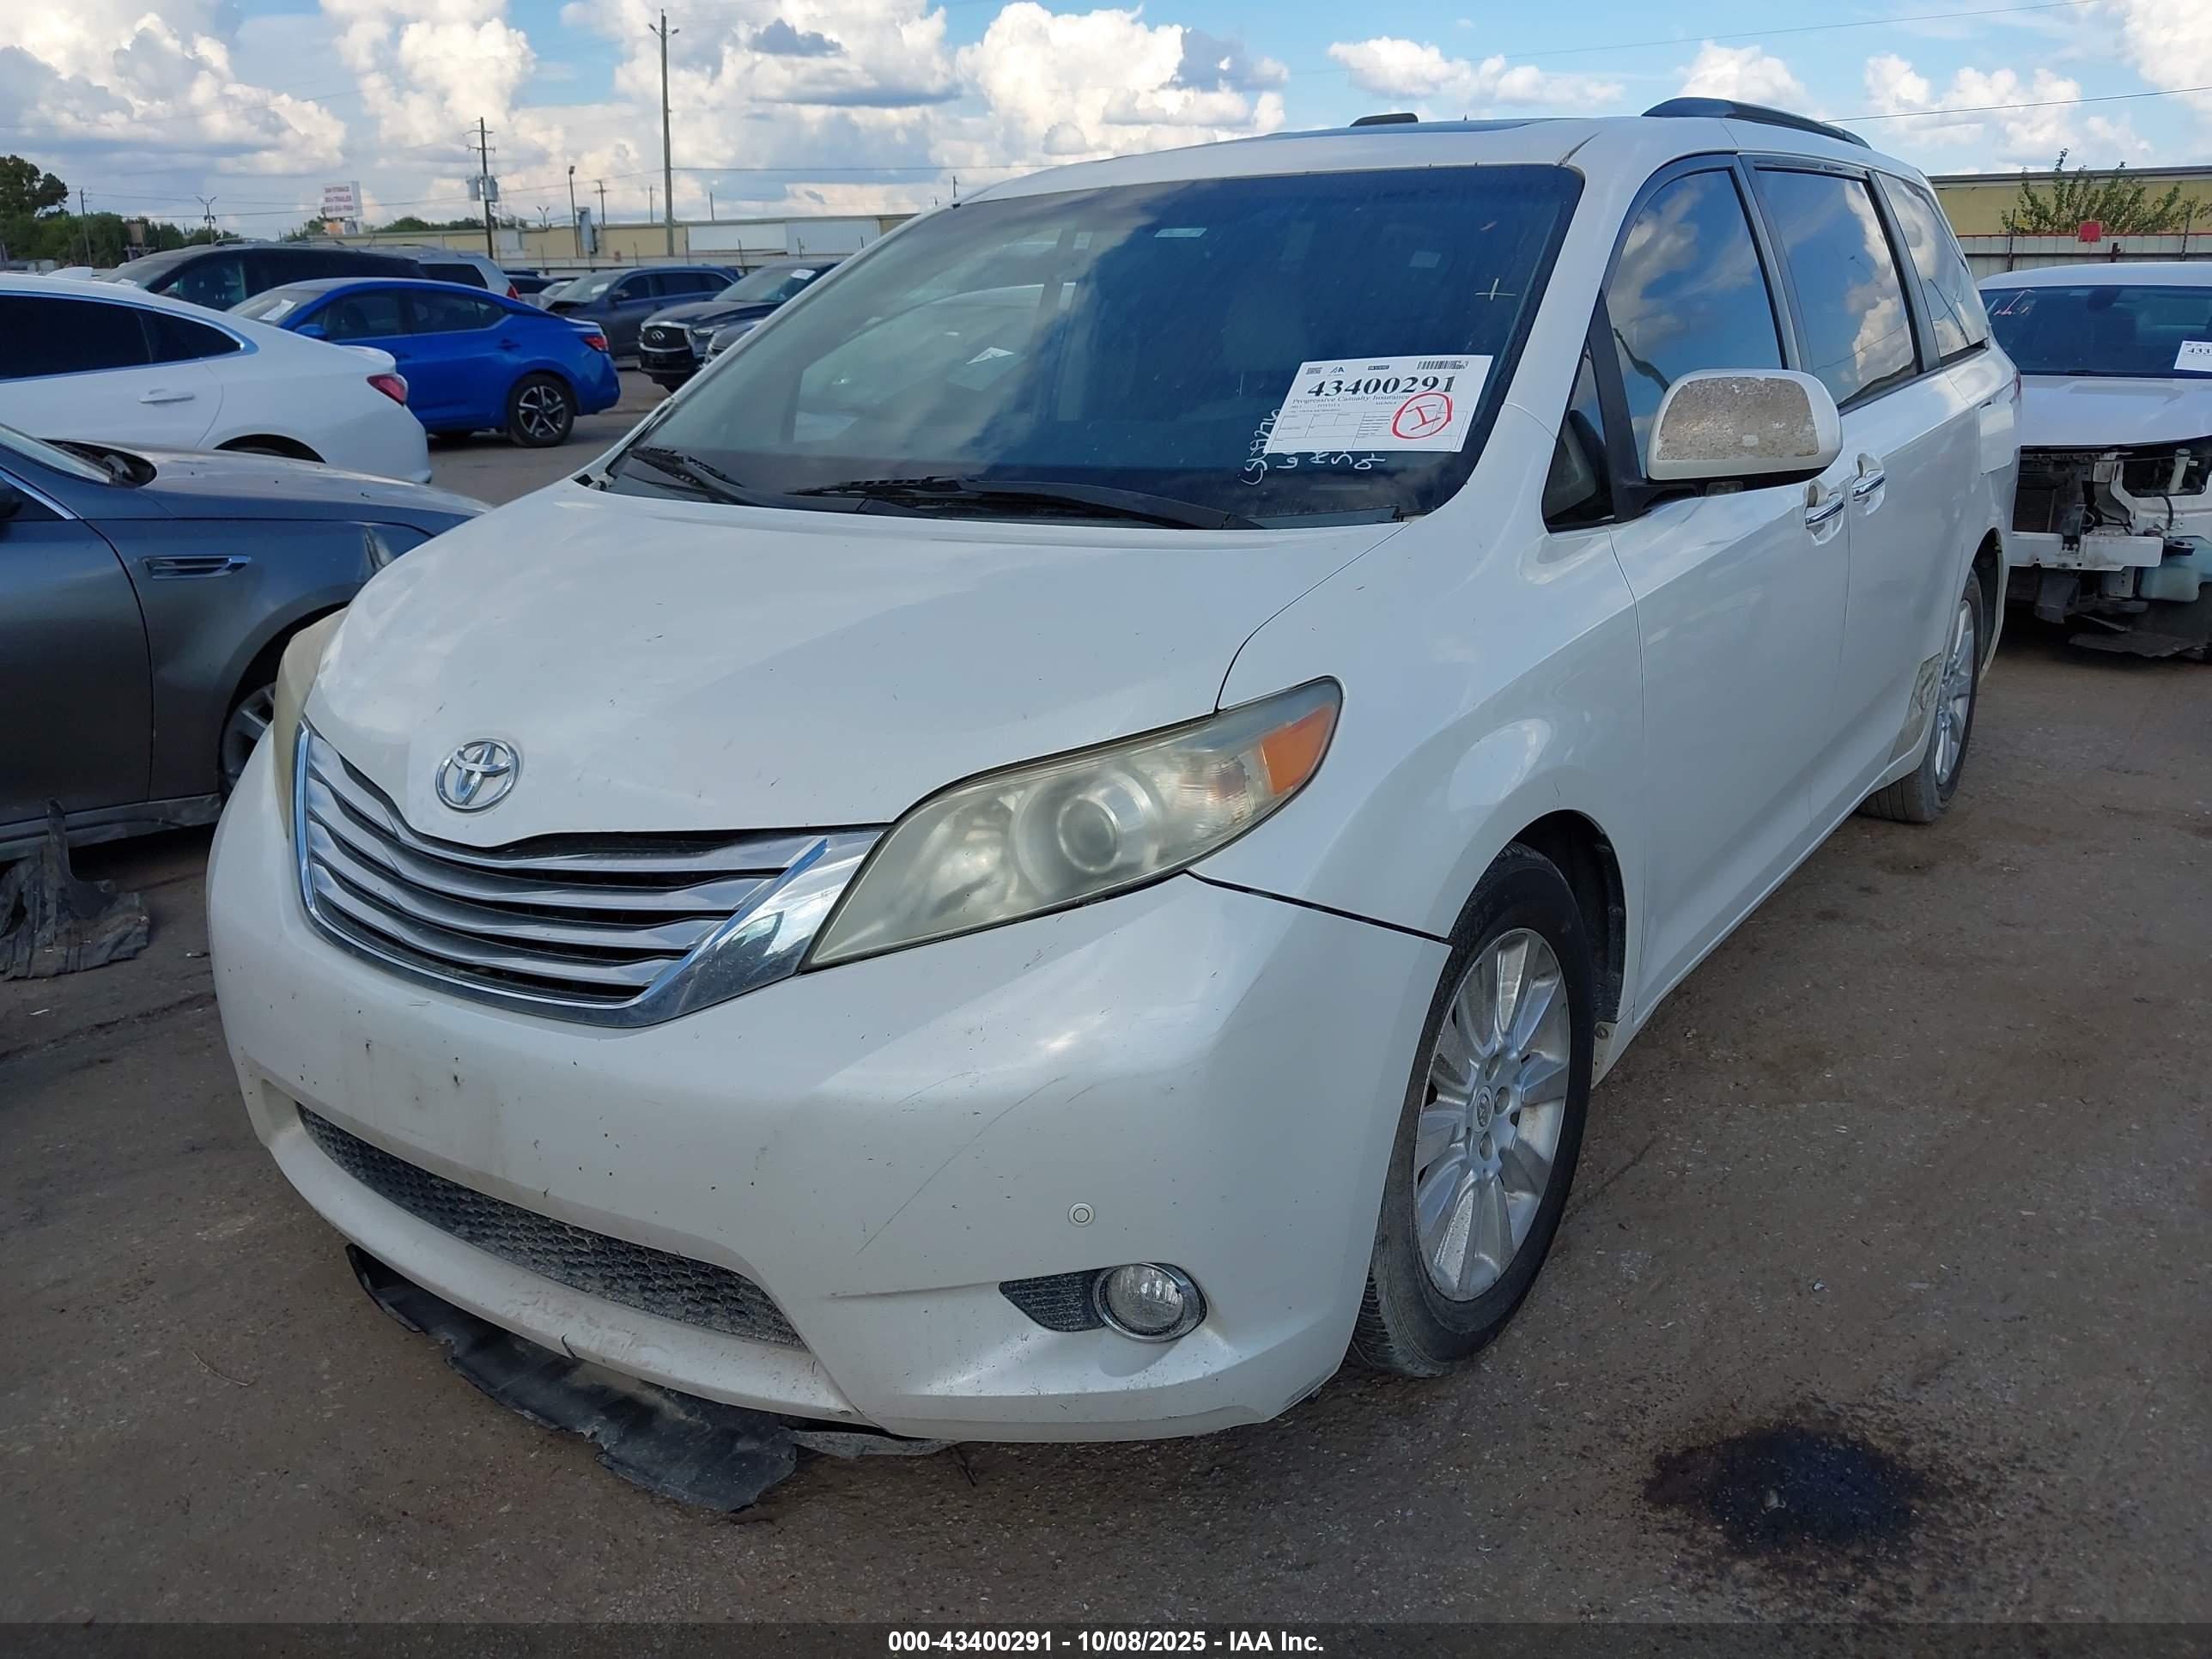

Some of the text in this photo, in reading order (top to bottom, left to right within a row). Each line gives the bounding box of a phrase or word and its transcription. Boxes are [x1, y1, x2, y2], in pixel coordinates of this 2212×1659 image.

[1307, 375, 1455, 397] 43400291
[1291, 396, 1336, 404] Progressive
[1337, 394, 1370, 403] Casualty
